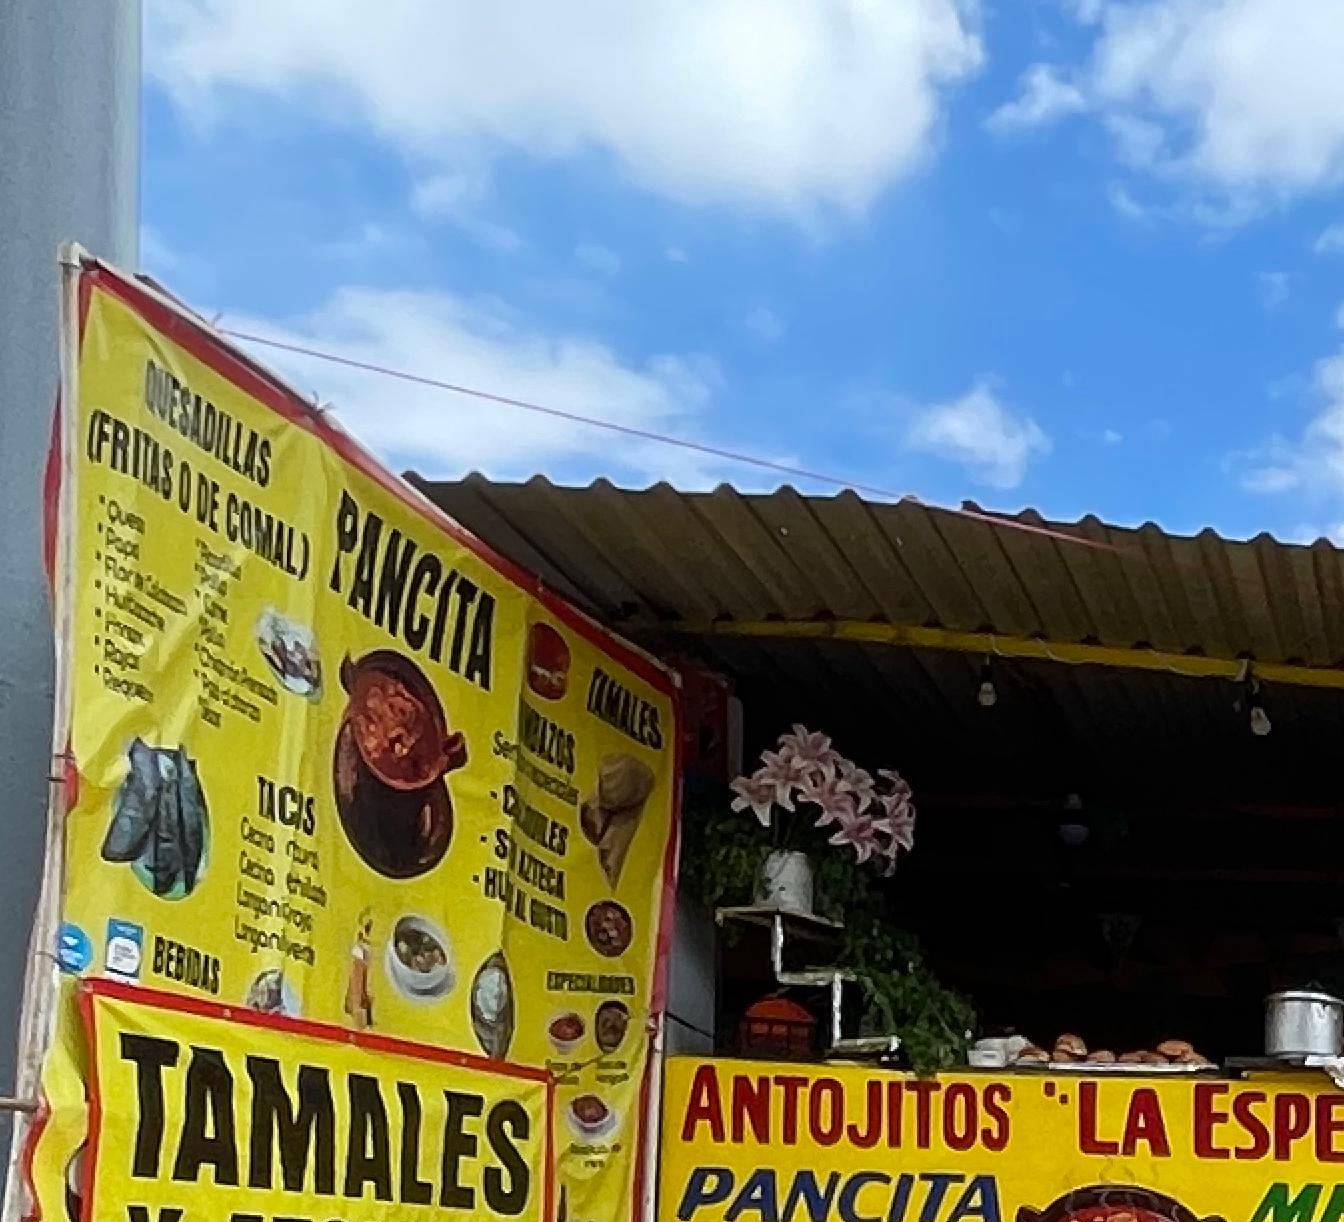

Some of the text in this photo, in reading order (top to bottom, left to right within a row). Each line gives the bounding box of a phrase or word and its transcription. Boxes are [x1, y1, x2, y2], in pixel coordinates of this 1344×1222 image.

[87, 409, 173, 500] (FRITAS
[178, 460, 191, 513] O
[196, 472, 220, 533] DE
[226, 492, 309, 581] COMAL)
[145, 359, 272, 487] QUESADILLAS
[329, 490, 497, 691] PANCITA
[120, 1033, 531, 1215] TAMALES
[683, 1064, 1011, 1151] ANTOJITOS
